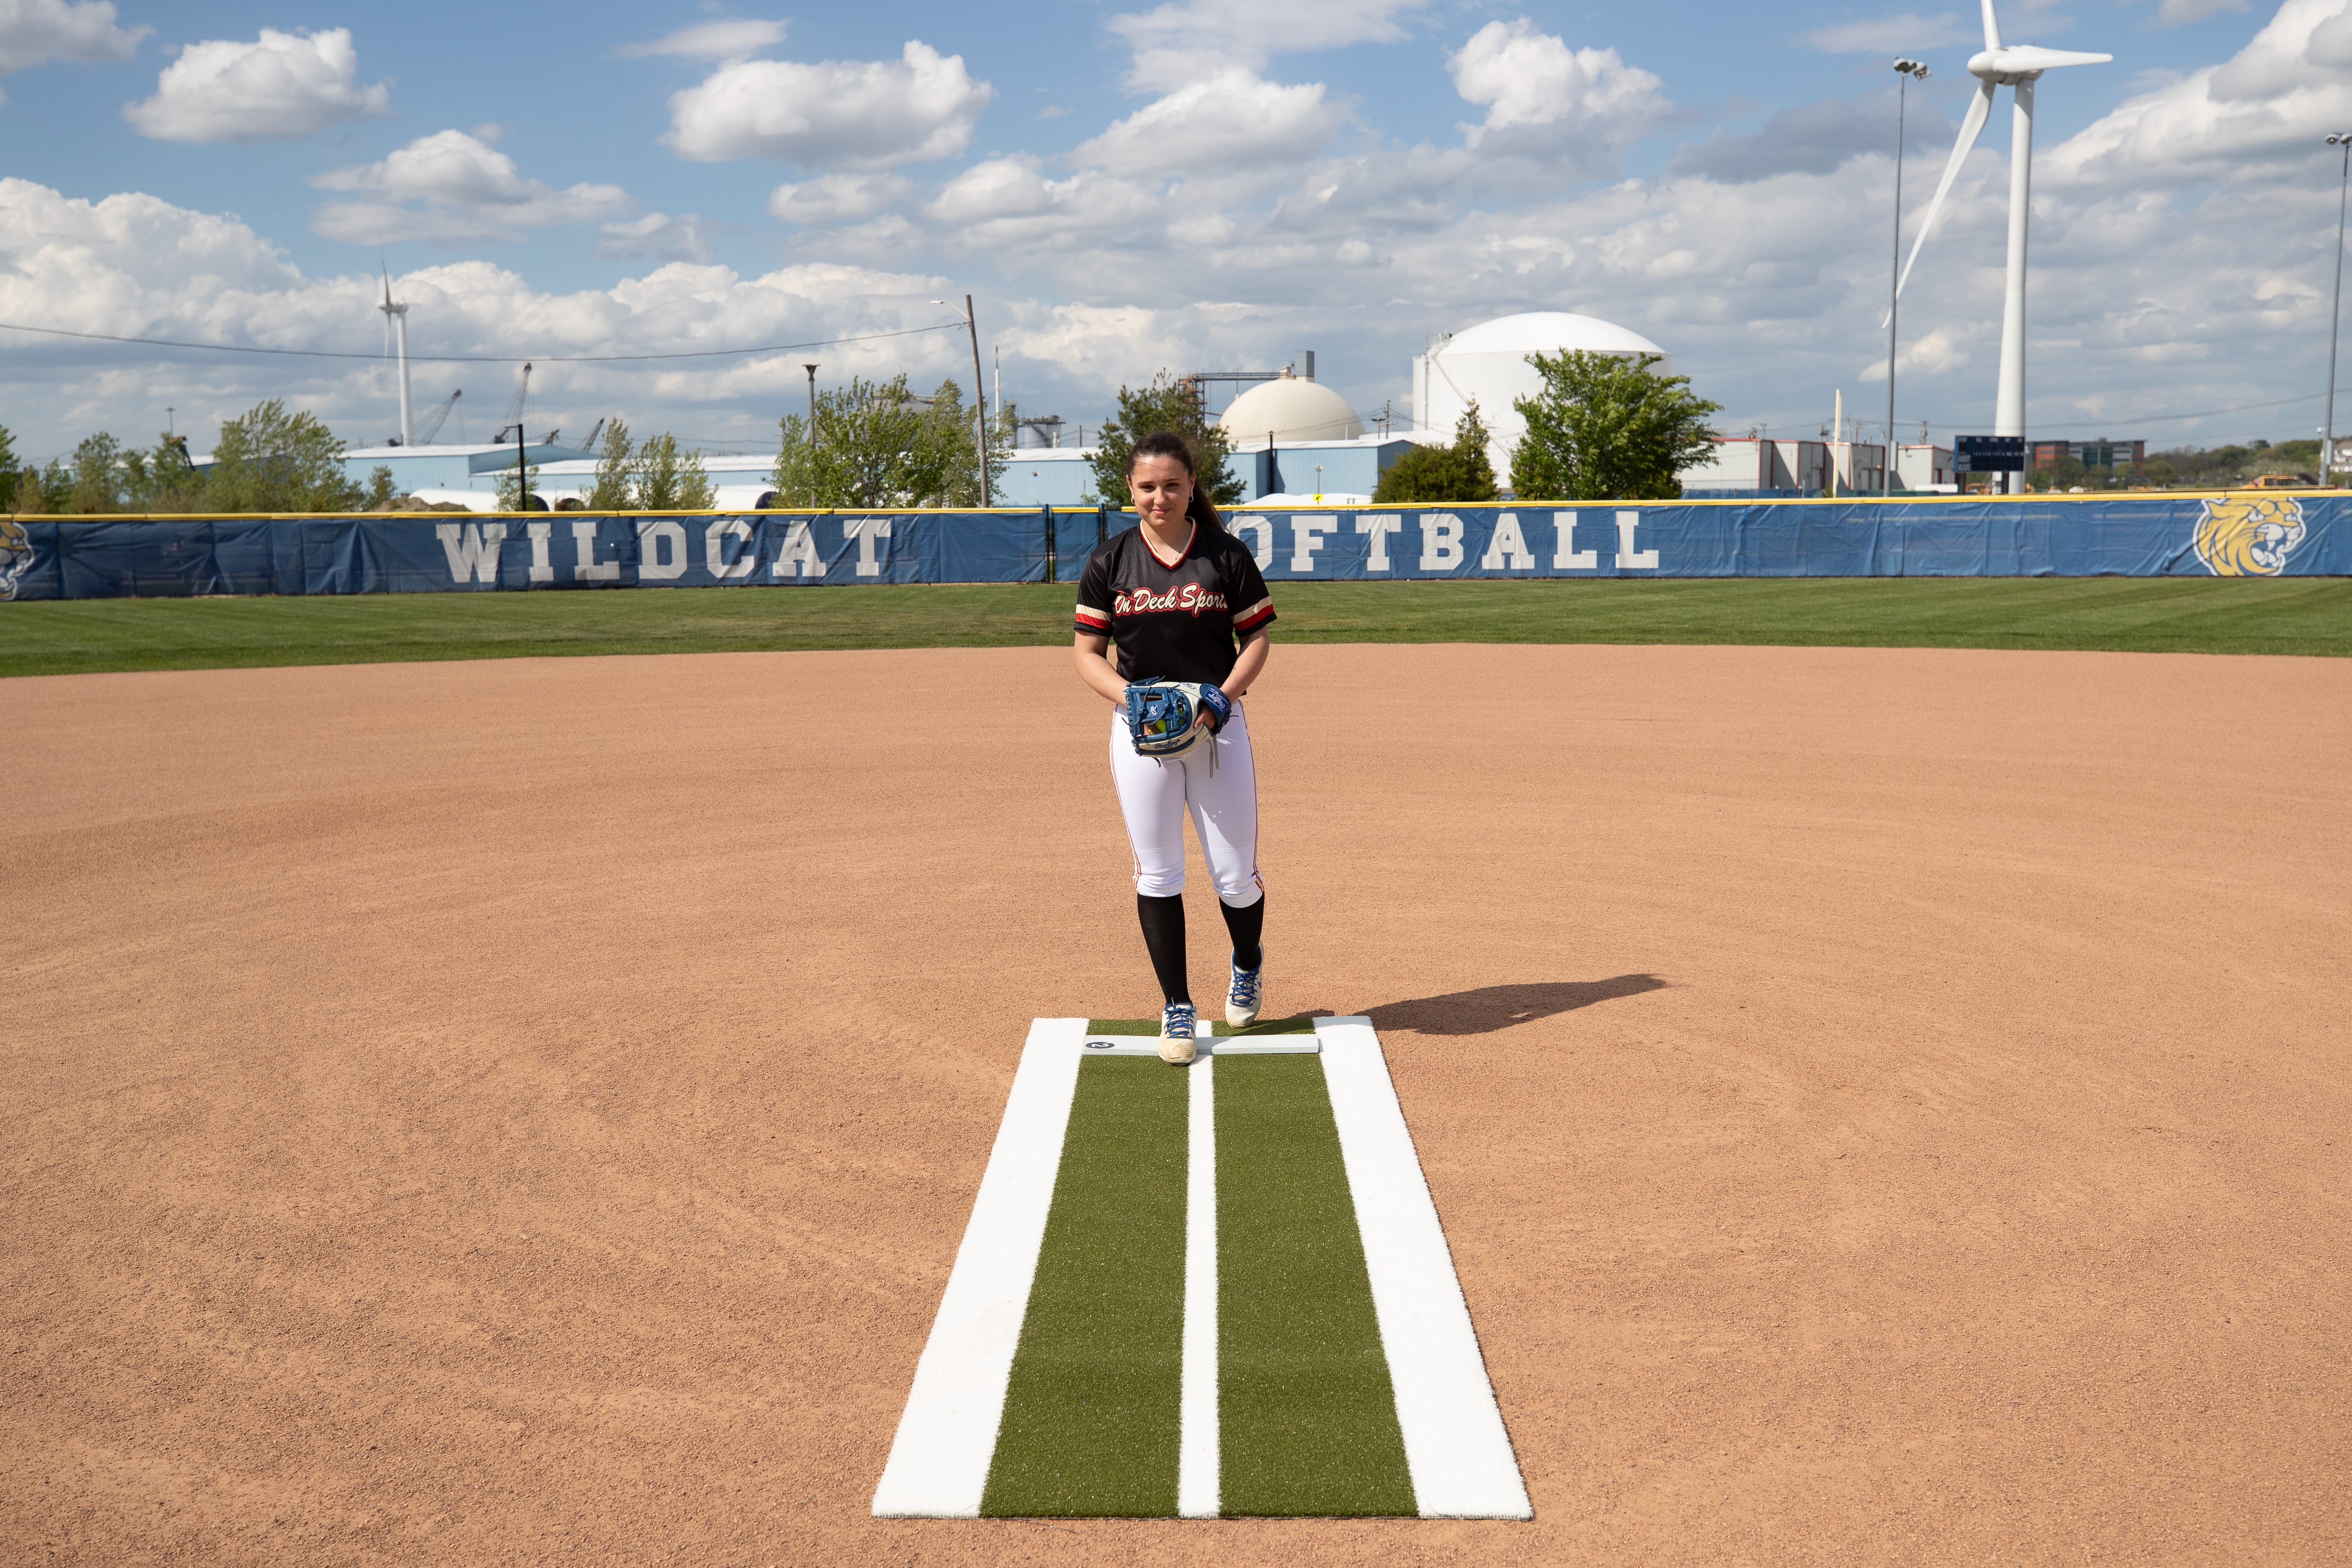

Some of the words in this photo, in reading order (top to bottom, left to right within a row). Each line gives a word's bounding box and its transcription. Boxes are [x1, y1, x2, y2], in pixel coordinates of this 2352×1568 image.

[436, 519, 891, 583] WILDCAT
[1225, 511, 1659, 571] OFTBALL
[1114, 592, 1132, 615] On
[1133, 587, 1177, 612] Deck
